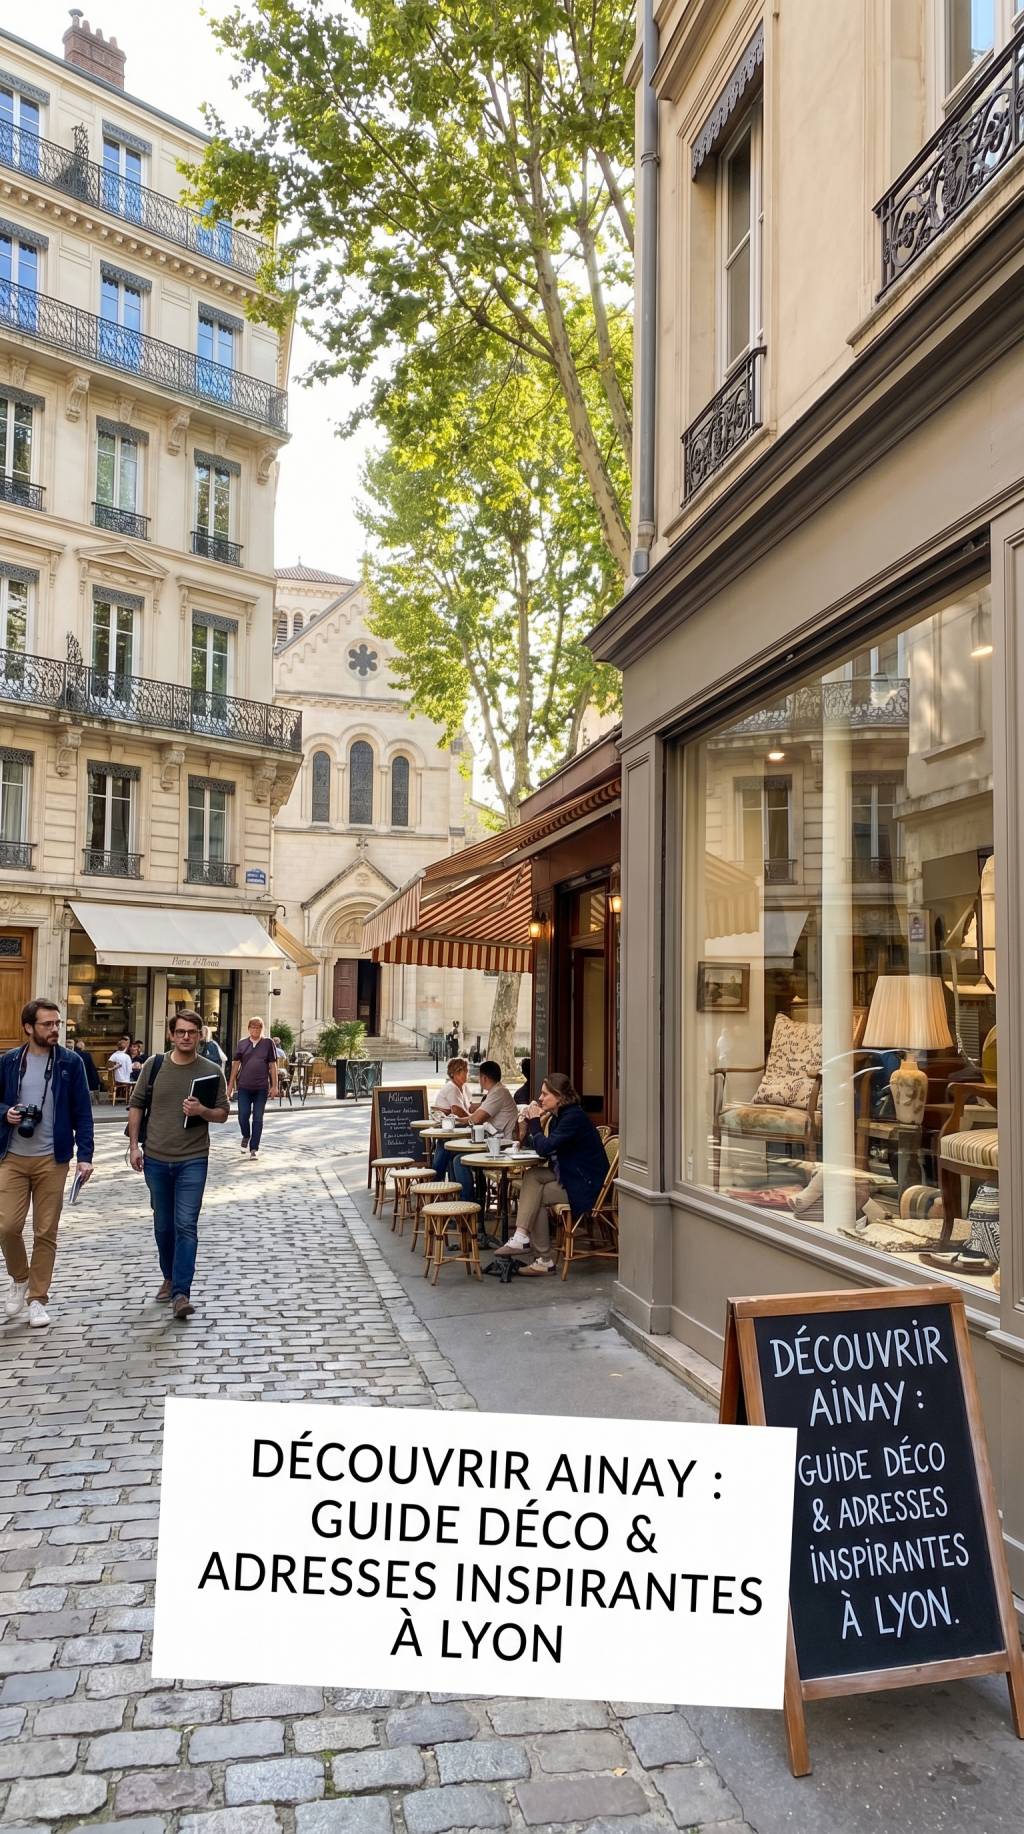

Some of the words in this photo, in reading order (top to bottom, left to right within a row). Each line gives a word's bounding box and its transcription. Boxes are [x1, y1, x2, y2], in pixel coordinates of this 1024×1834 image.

[884, 1436, 946, 1477] DÉCO
[812, 1497, 832, 1534] &
[838, 1485, 948, 1530] ADRESSES
[841, 1590, 863, 1640] À
[874, 1586, 960, 1638] LYON.
